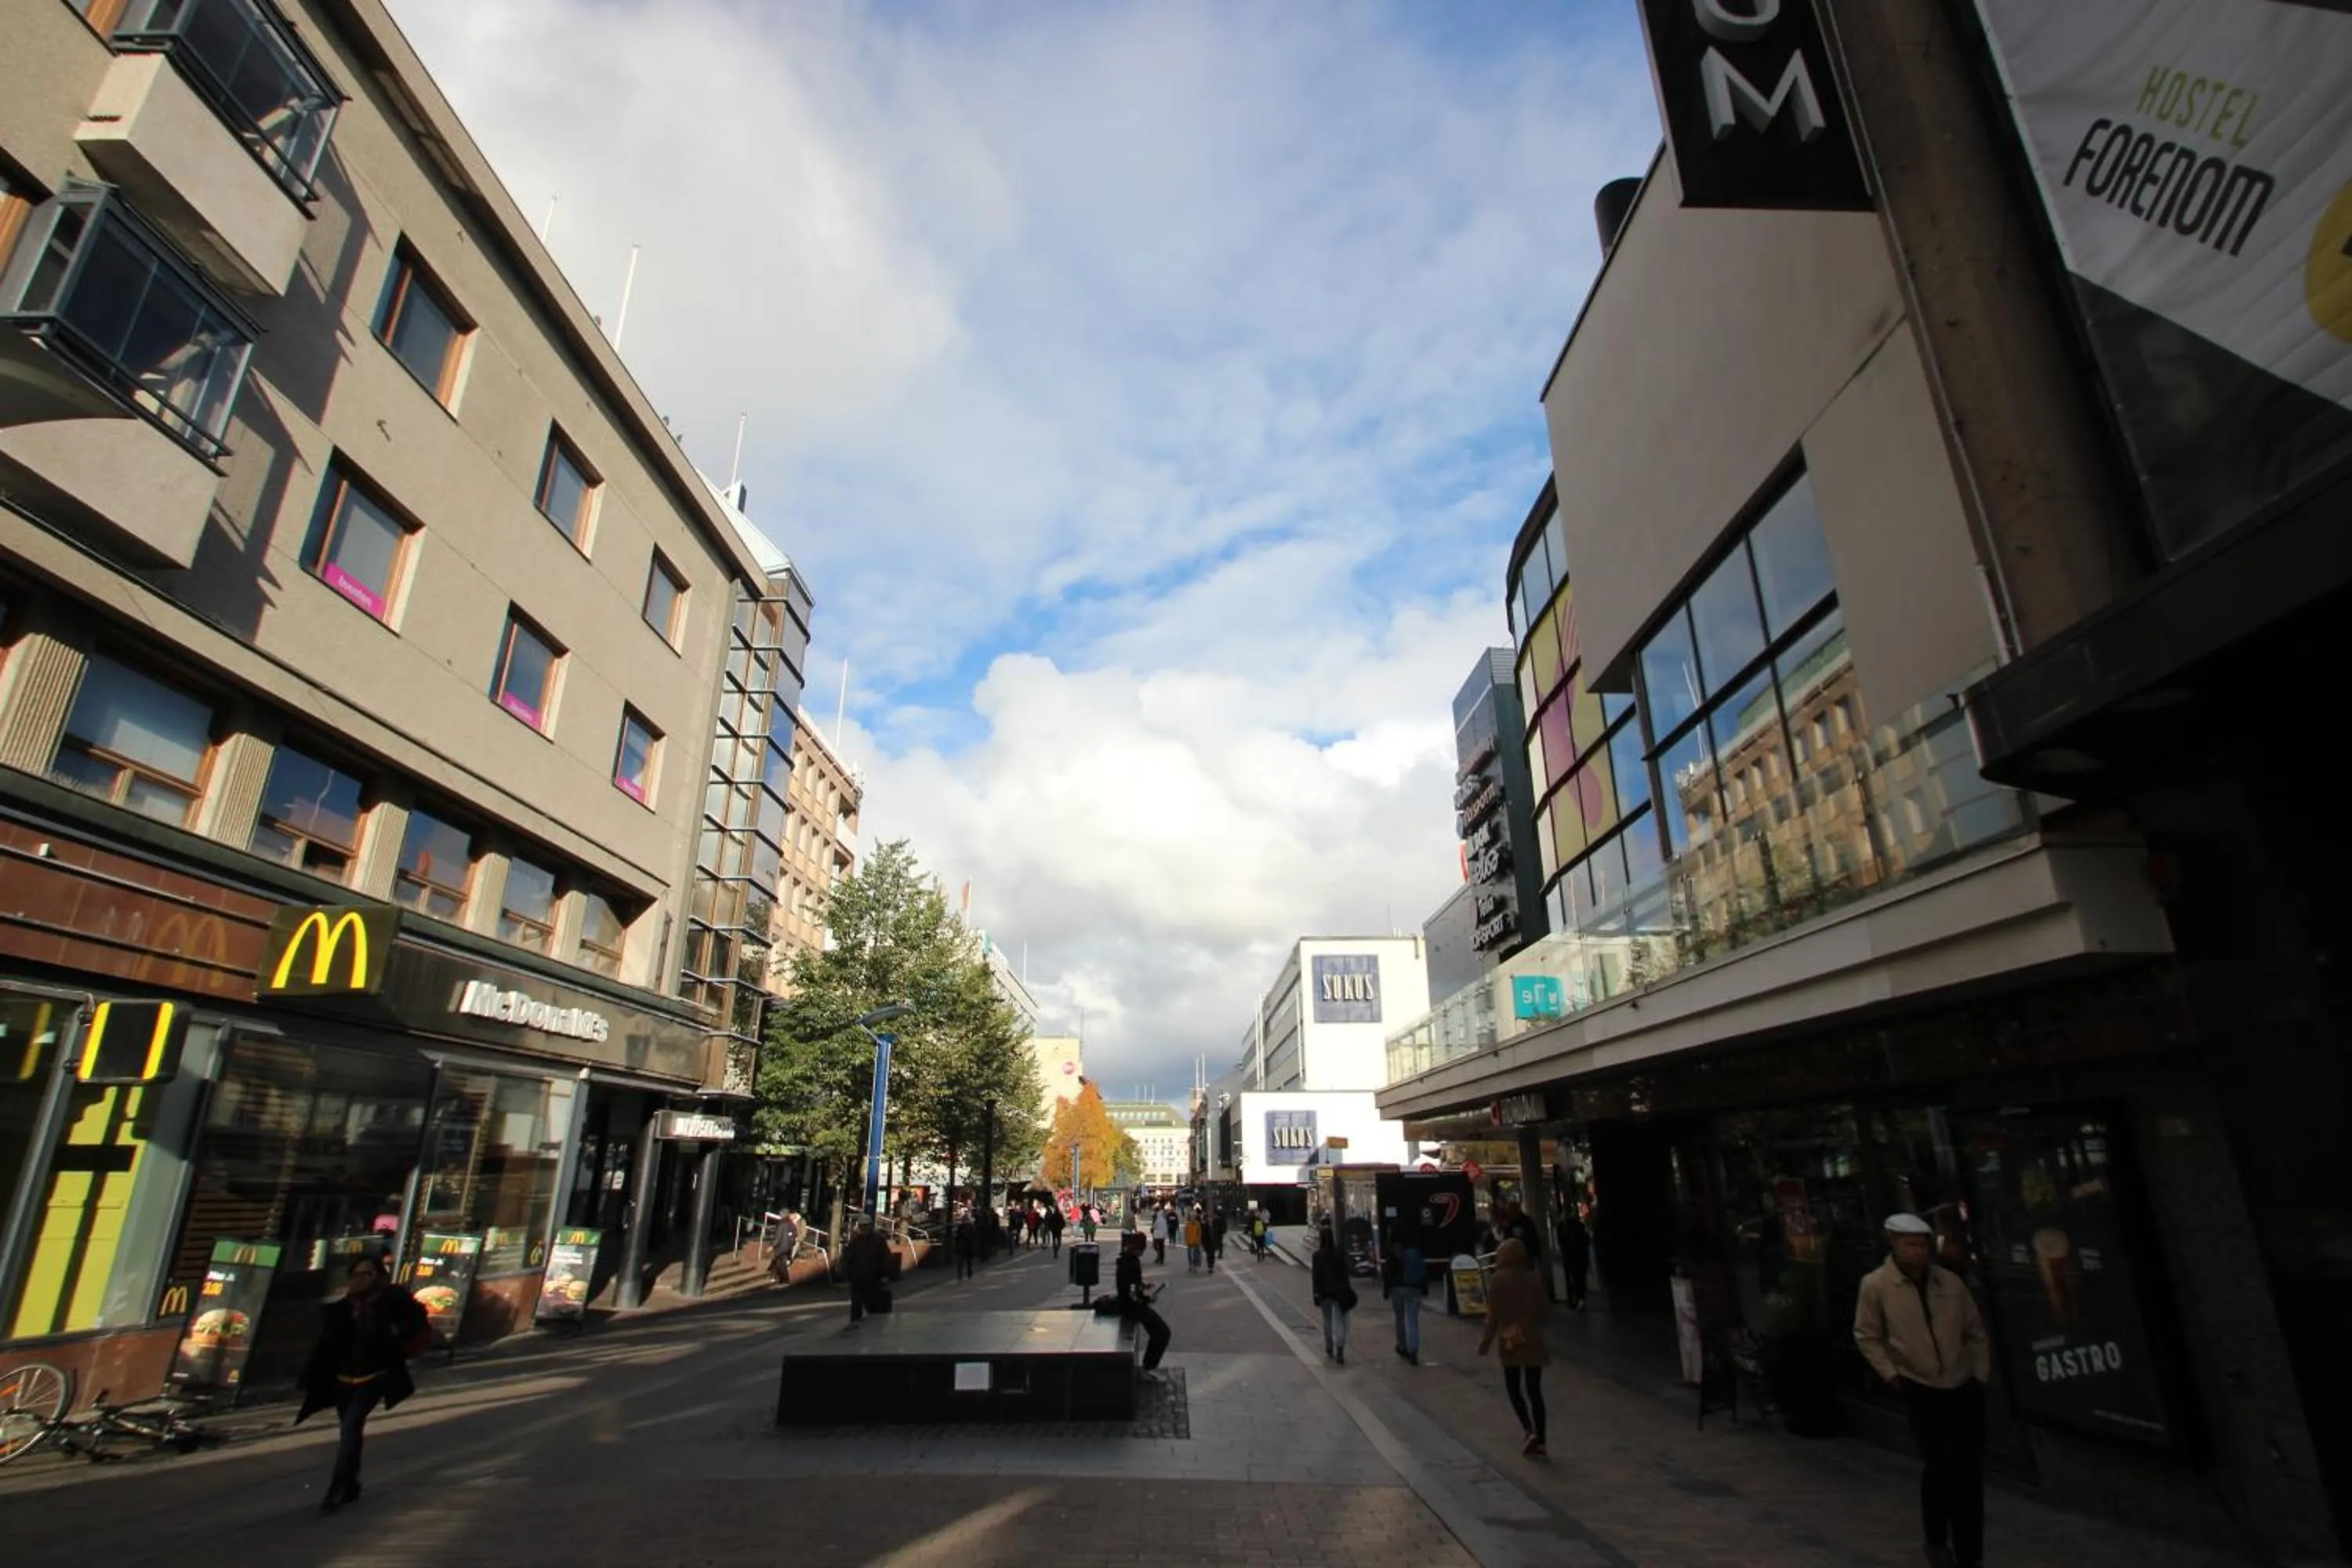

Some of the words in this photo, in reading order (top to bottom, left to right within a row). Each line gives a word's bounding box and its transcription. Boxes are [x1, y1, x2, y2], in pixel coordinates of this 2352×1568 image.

[2136, 64, 2259, 148] HOSTEL
[2063, 118, 2276, 257] FORENOM
[2034, 1341, 2123, 1382] GASTRO
